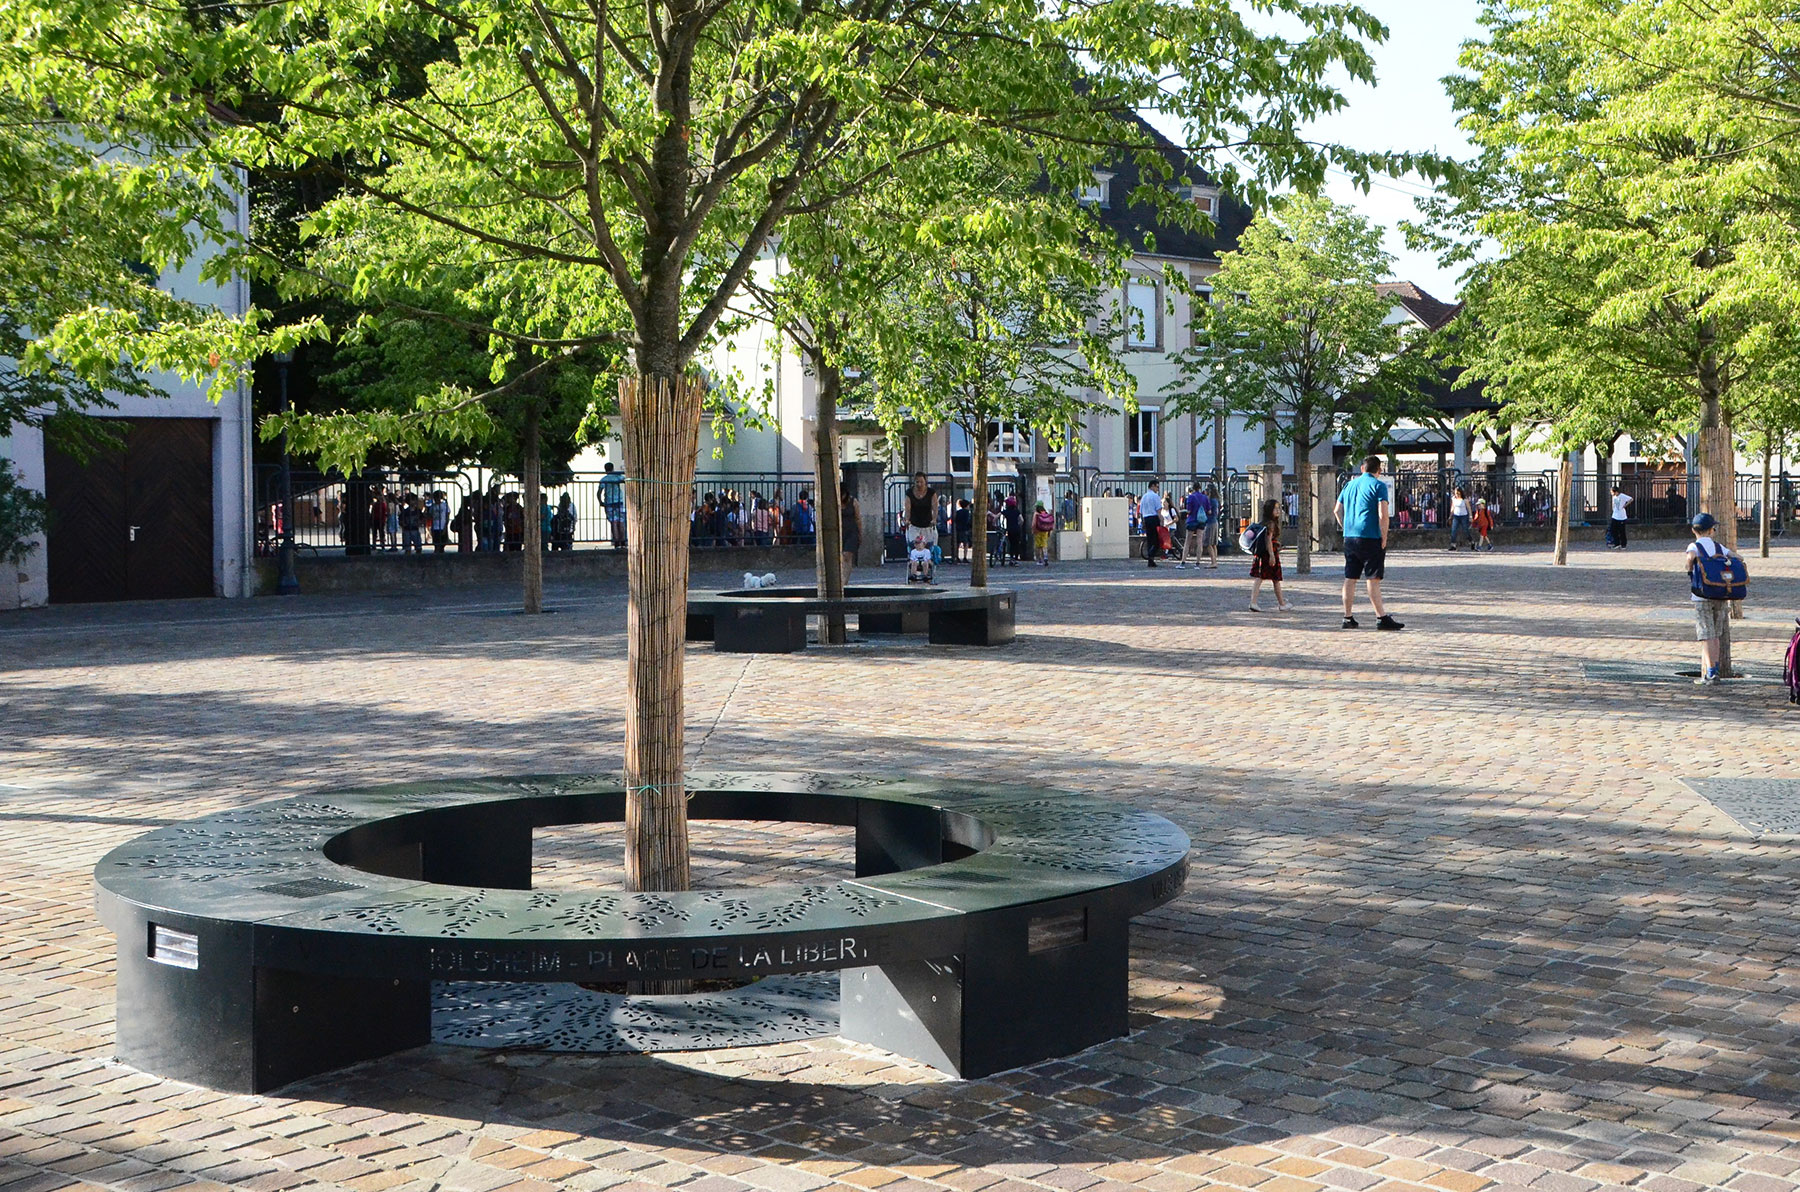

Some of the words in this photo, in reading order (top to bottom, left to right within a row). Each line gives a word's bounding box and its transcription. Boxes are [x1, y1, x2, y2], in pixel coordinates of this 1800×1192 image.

[588, 948, 681, 972] PLACE
[691, 947, 728, 970] DE
[739, 945, 772, 967] LA
